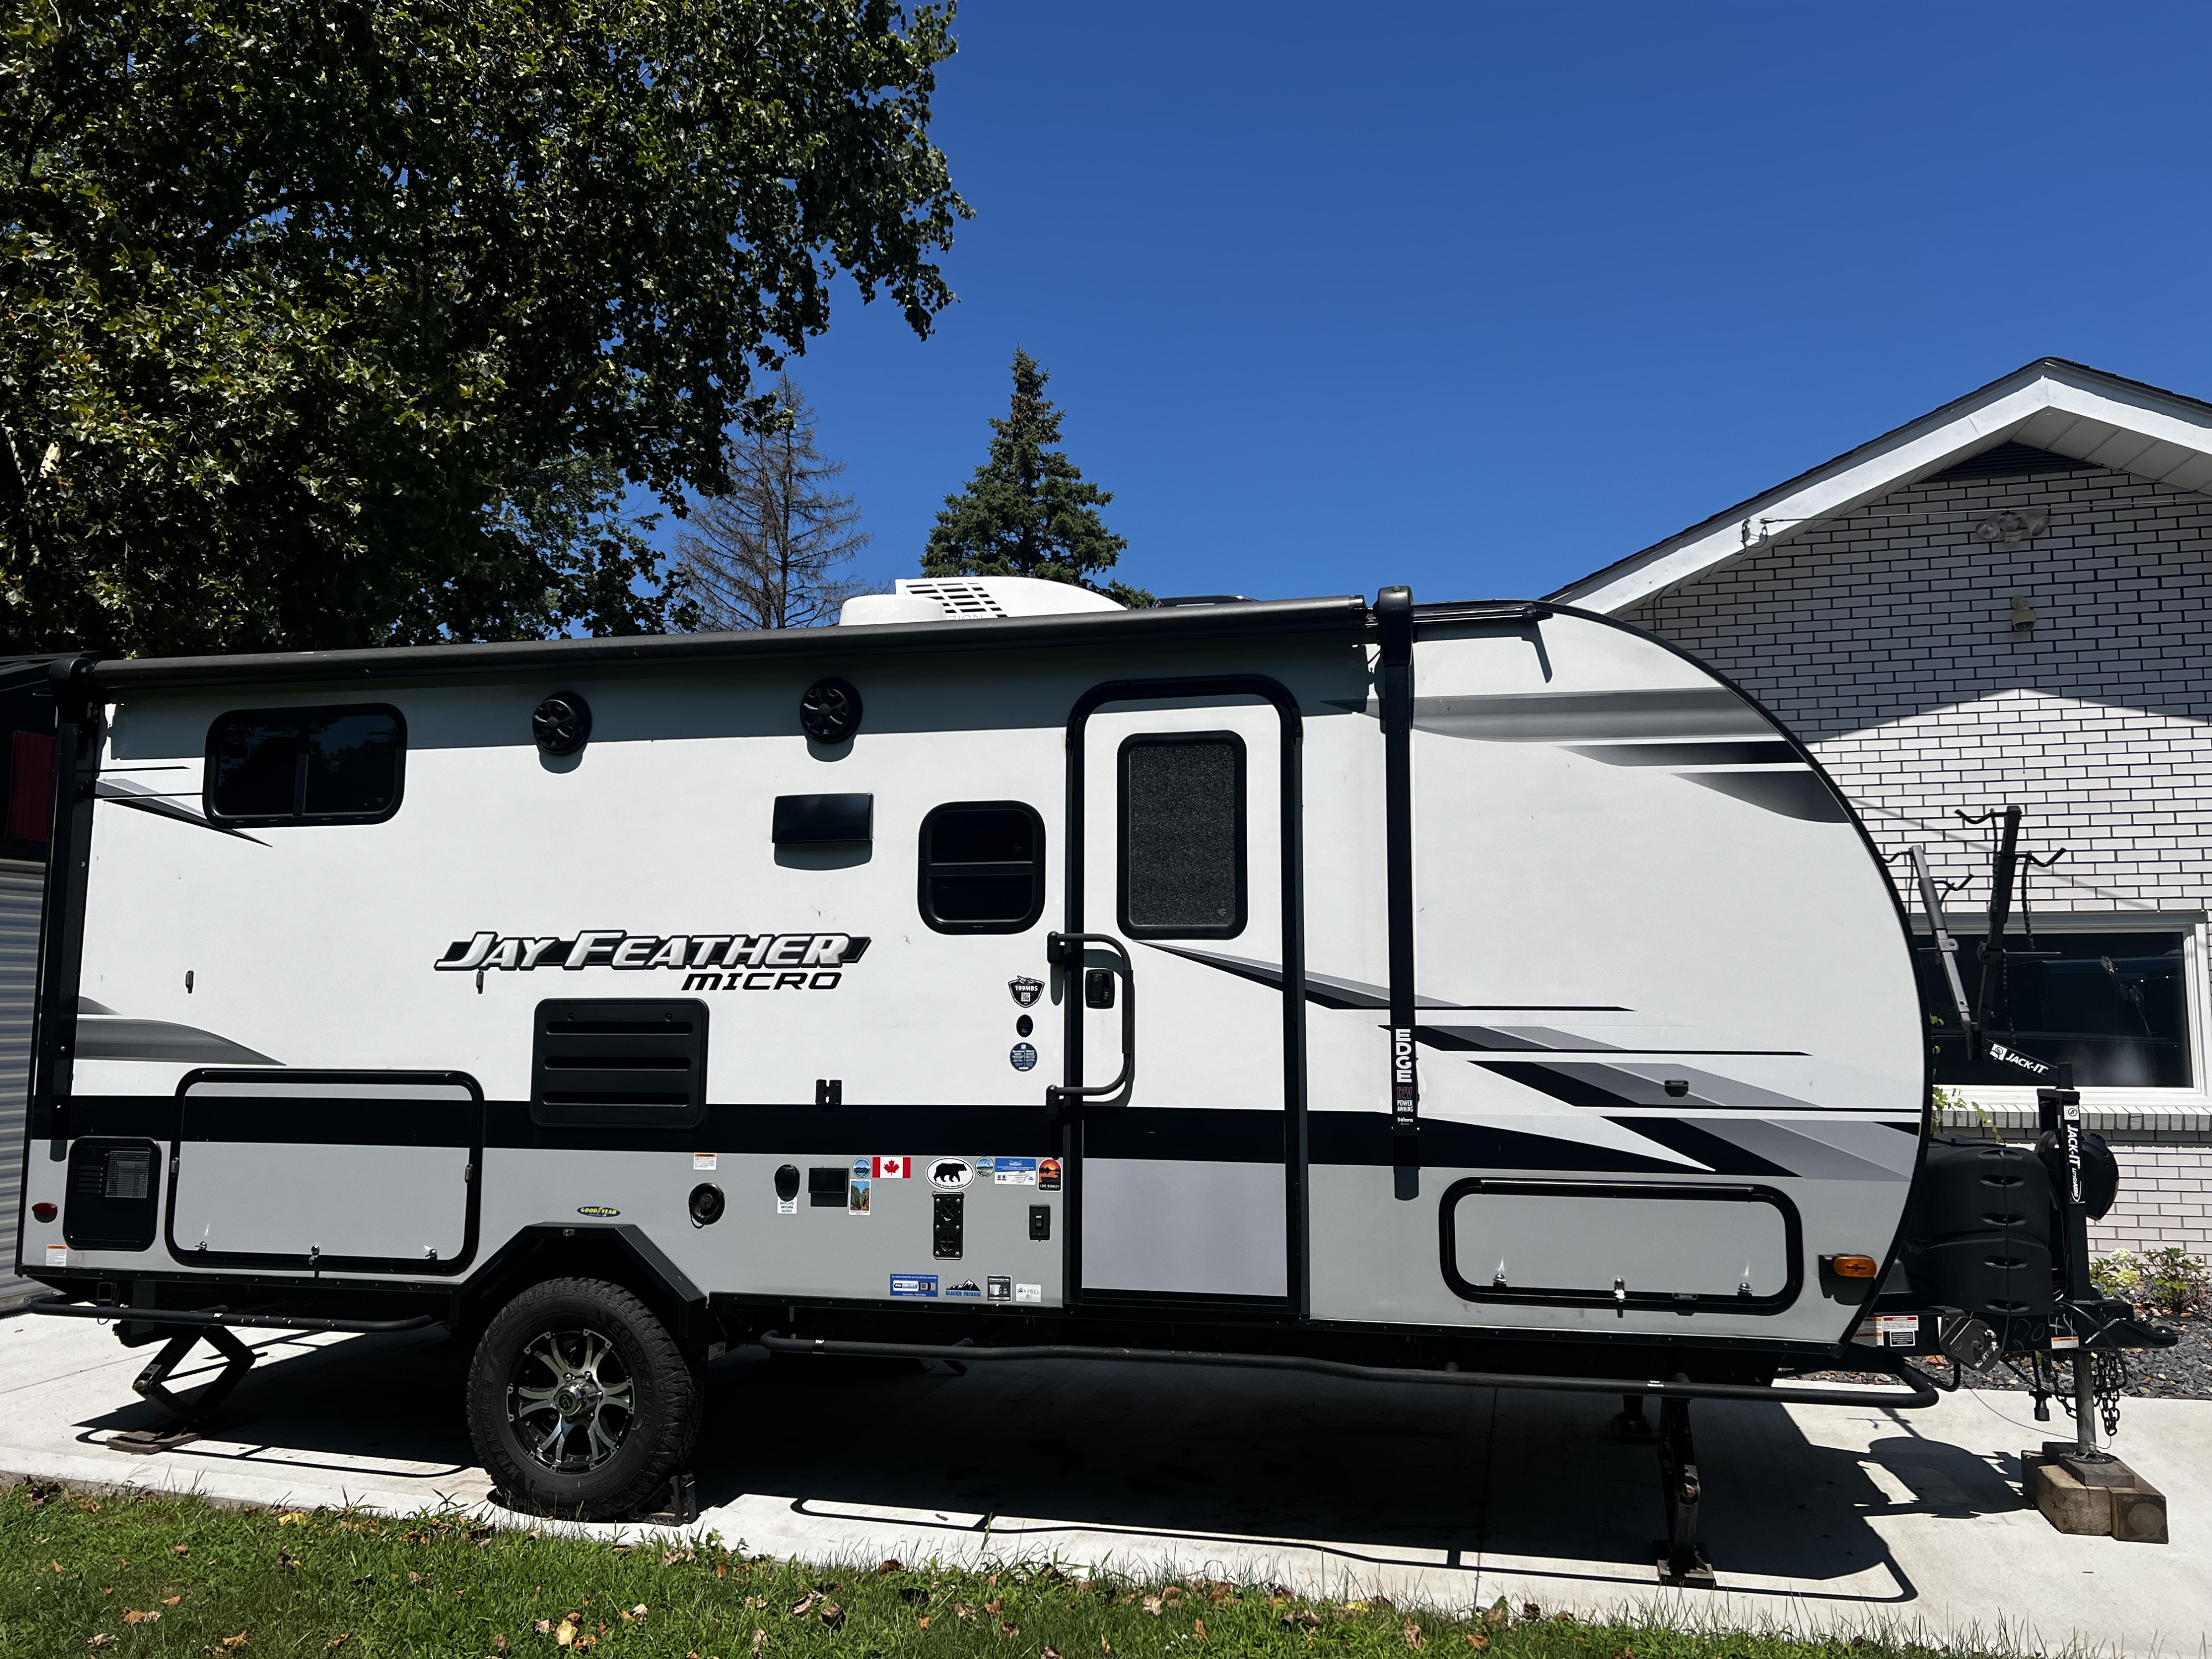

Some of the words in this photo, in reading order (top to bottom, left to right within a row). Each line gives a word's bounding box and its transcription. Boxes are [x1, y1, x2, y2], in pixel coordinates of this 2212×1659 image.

[434, 931, 559, 969] JAY
[565, 930, 852, 969] FEATHER
[682, 972, 842, 991] MICRO
[1395, 1029, 1412, 1083] EDGE
[2005, 1053, 2049, 1073] JACK-IT
[1396, 1086, 1413, 1100] 12V
[2067, 1124, 2081, 1168] JACK-IT
